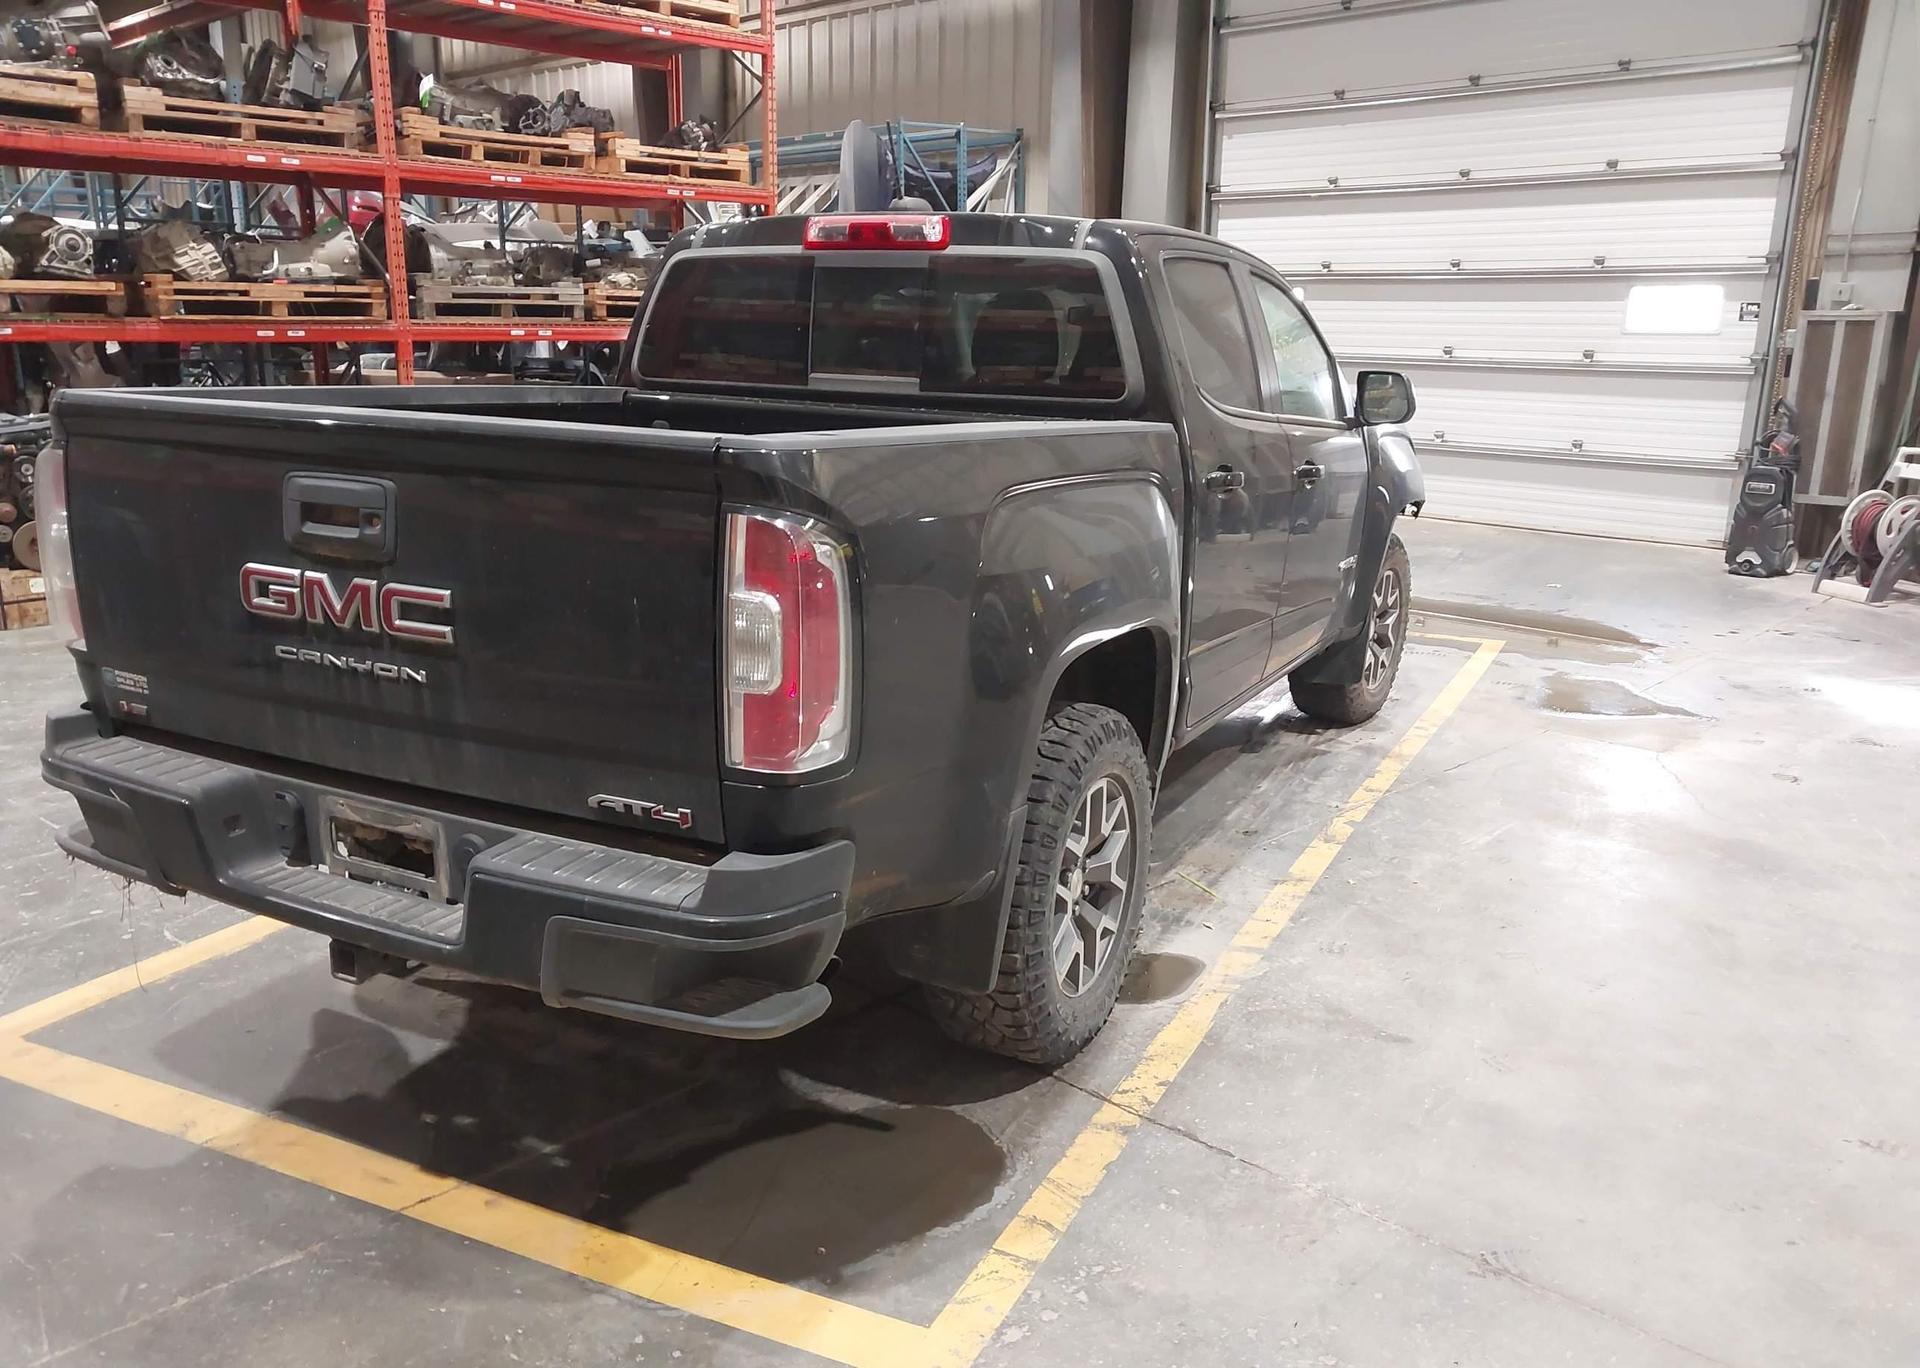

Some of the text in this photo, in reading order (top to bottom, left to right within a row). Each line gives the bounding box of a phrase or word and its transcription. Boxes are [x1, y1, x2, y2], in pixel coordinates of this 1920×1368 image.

[240, 562, 454, 644] GMC
[274, 645, 427, 684] CANYON
[587, 793, 692, 829] AT4
